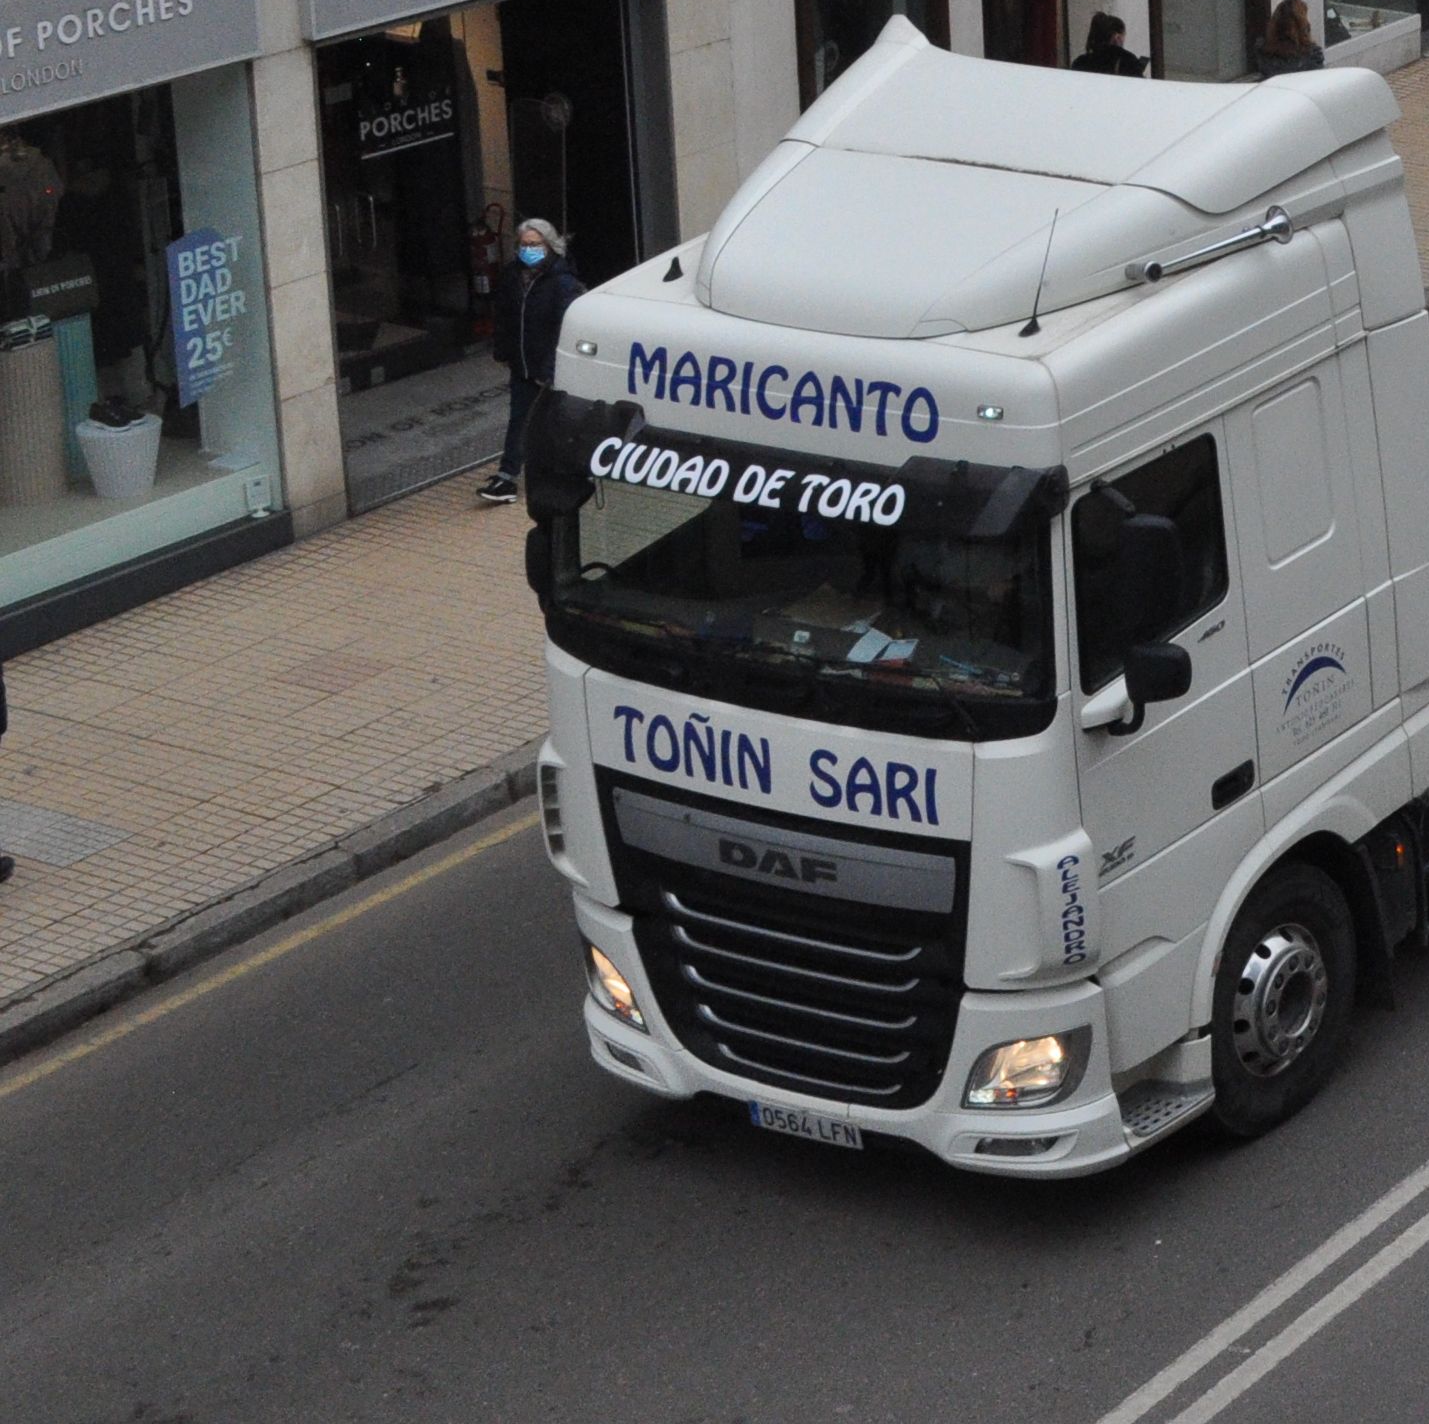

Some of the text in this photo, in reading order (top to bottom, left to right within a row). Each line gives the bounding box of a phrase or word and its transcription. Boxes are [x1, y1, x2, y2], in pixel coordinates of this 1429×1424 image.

[1, 58, 83, 95] LONDON
[360, 99, 452, 141] PORCHES
[178, 235, 243, 277] BEST
[180, 267, 232, 305] DAD
[183, 290, 246, 332] EVER
[187, 327, 233, 368] 25€
[627, 341, 939, 443] MARICANTO
[590, 437, 905, 527] CIUDAD DE TORO
[1281, 643, 1345, 695] TRANSPORTES
[613, 705, 939, 826] TOÑIN SARI
[718, 838, 838, 883] DAF
[1058, 855, 1086, 965] ALEJANDRO
[763, 1107, 857, 1146] 0564 LFN
